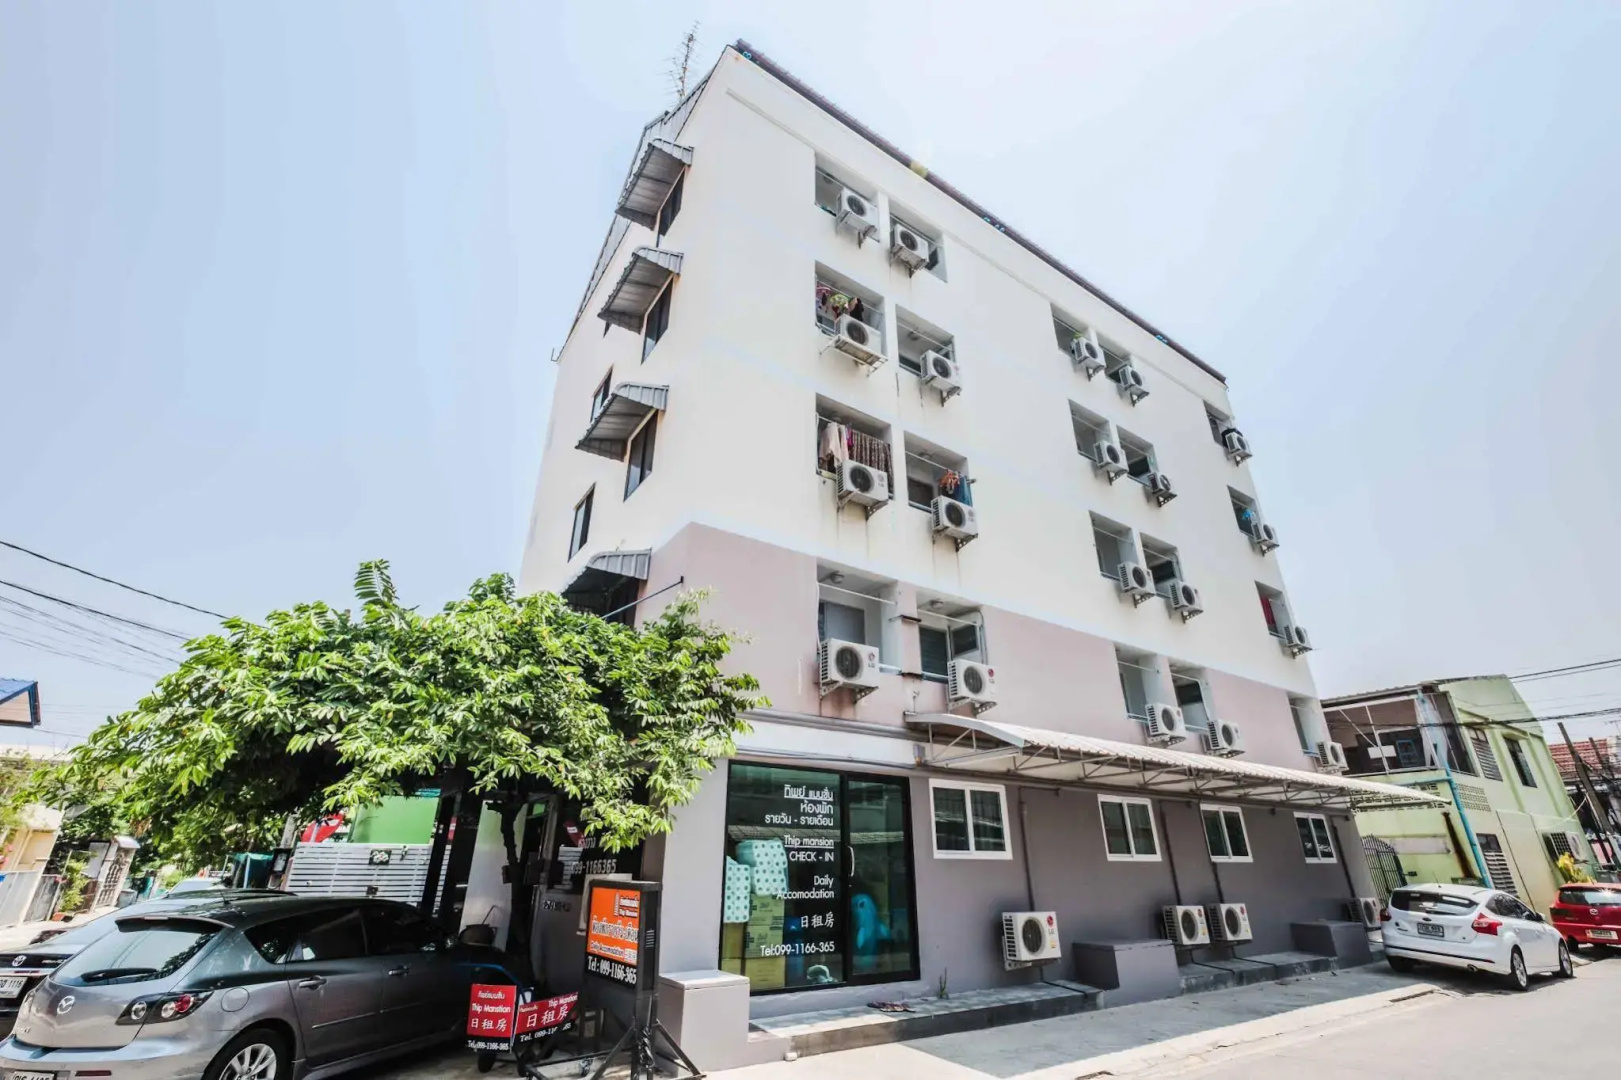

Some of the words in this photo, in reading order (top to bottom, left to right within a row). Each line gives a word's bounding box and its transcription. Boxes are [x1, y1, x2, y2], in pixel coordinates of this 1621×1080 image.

[765, 812, 792, 824] รายวัน
[784, 834, 801, 849] Thip
[803, 837, 835, 847] mansion
[789, 851, 817, 861] CHECK
[825, 852, 834, 861] IN
[814, 874, 834, 888] Daily
[776, 888, 835, 899] Accomodation
[801, 911, 835, 928] 日租房
[600, 959, 637, 984] 099-1166-365
[472, 1002, 483, 1014] Thip
[527, 1003, 569, 1028] 日租房
[471, 1018, 507, 1032] 日租房
